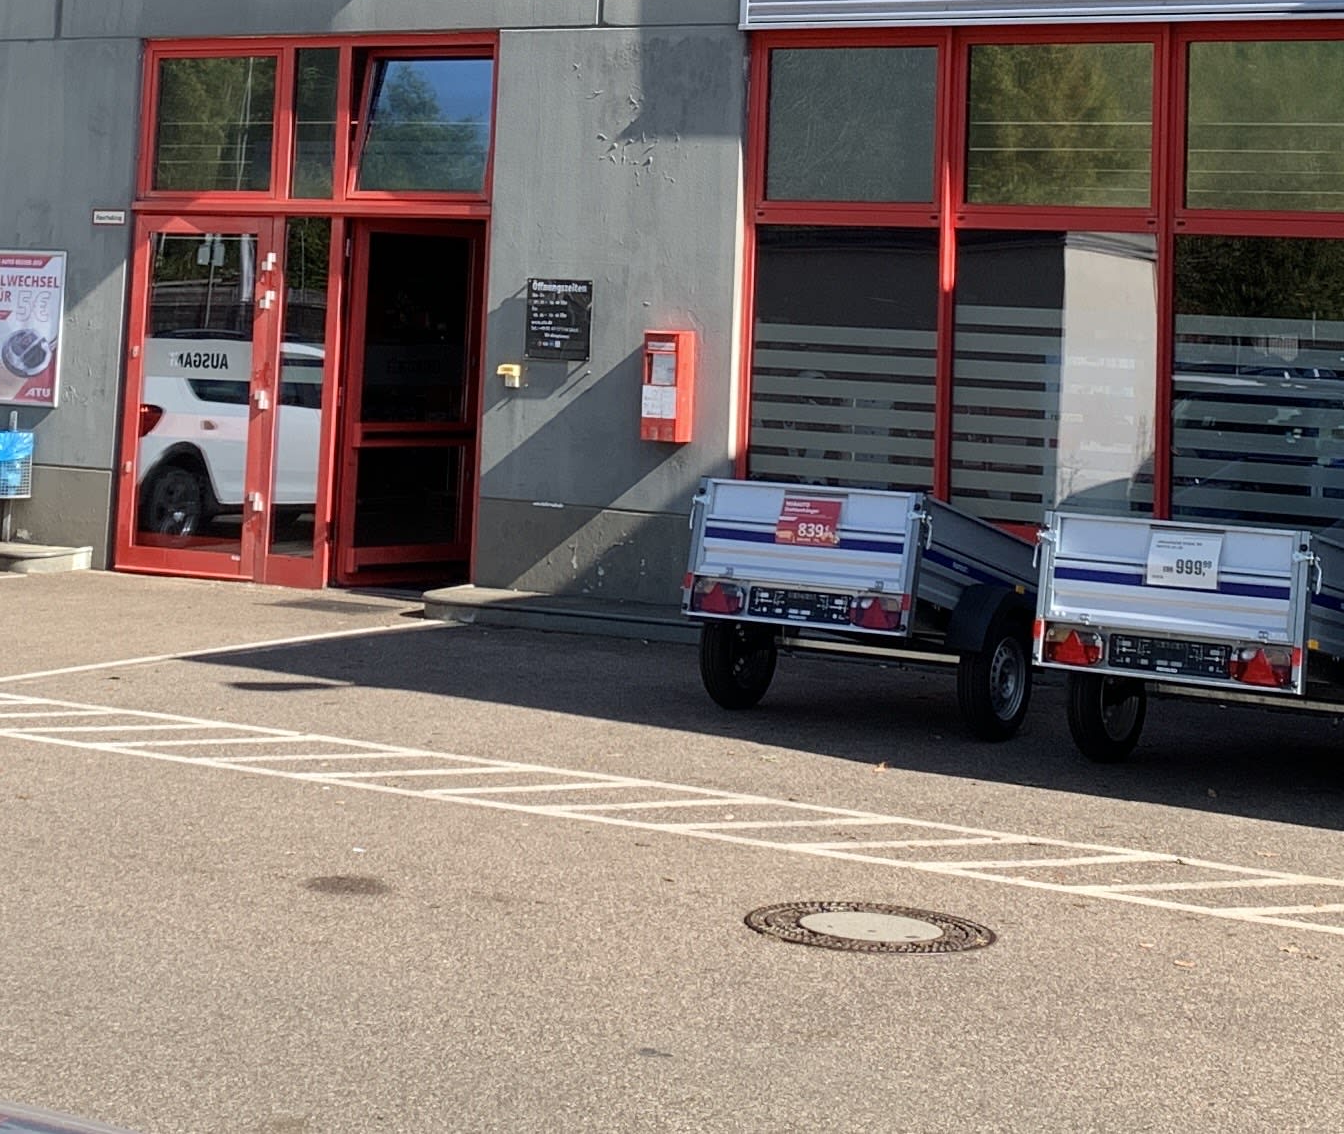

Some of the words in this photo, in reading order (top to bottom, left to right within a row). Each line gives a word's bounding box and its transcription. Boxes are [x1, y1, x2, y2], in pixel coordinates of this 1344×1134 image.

[532, 280, 587, 294] Öffnungszeiten
[16, 290, 51, 322] 5€
[25, 388, 51, 397] ATU
